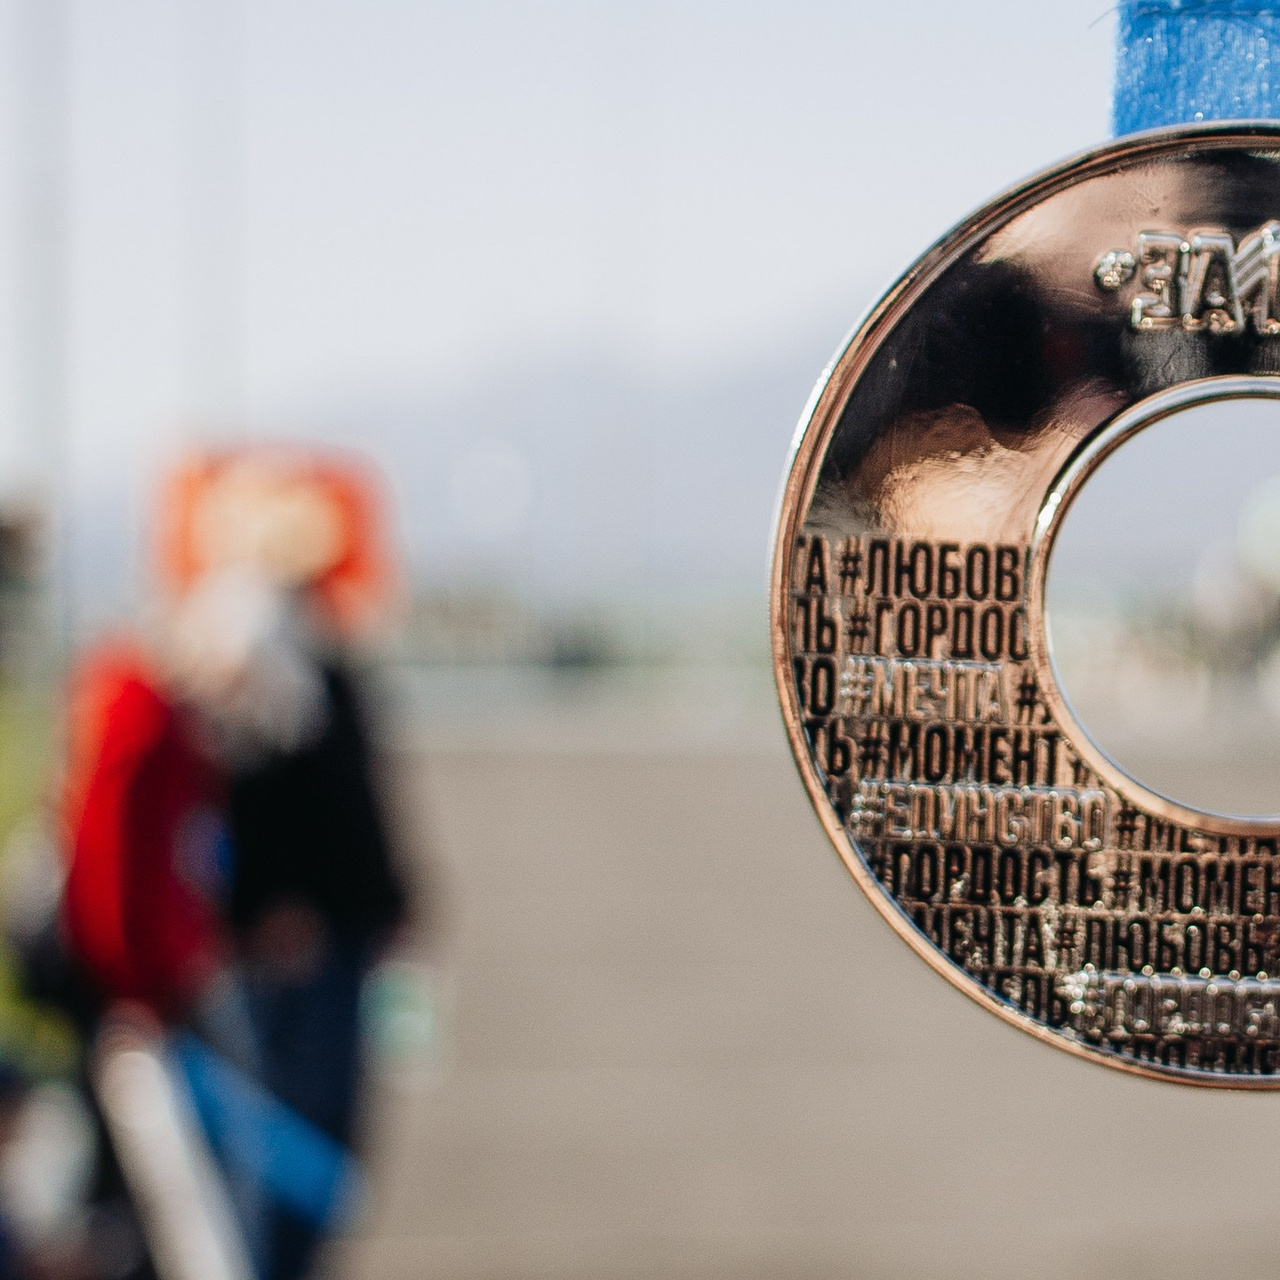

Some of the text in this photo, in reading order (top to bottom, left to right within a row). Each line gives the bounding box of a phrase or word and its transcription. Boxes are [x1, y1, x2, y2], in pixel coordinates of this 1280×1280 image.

[797, 535, 1032, 601] А #ЛЮБОВ
[840, 657, 1008, 720] #МЕЧТА
[857, 720, 1062, 787] #МОМЕНТ
[850, 780, 1108, 850] #ЕДИНСТВО
